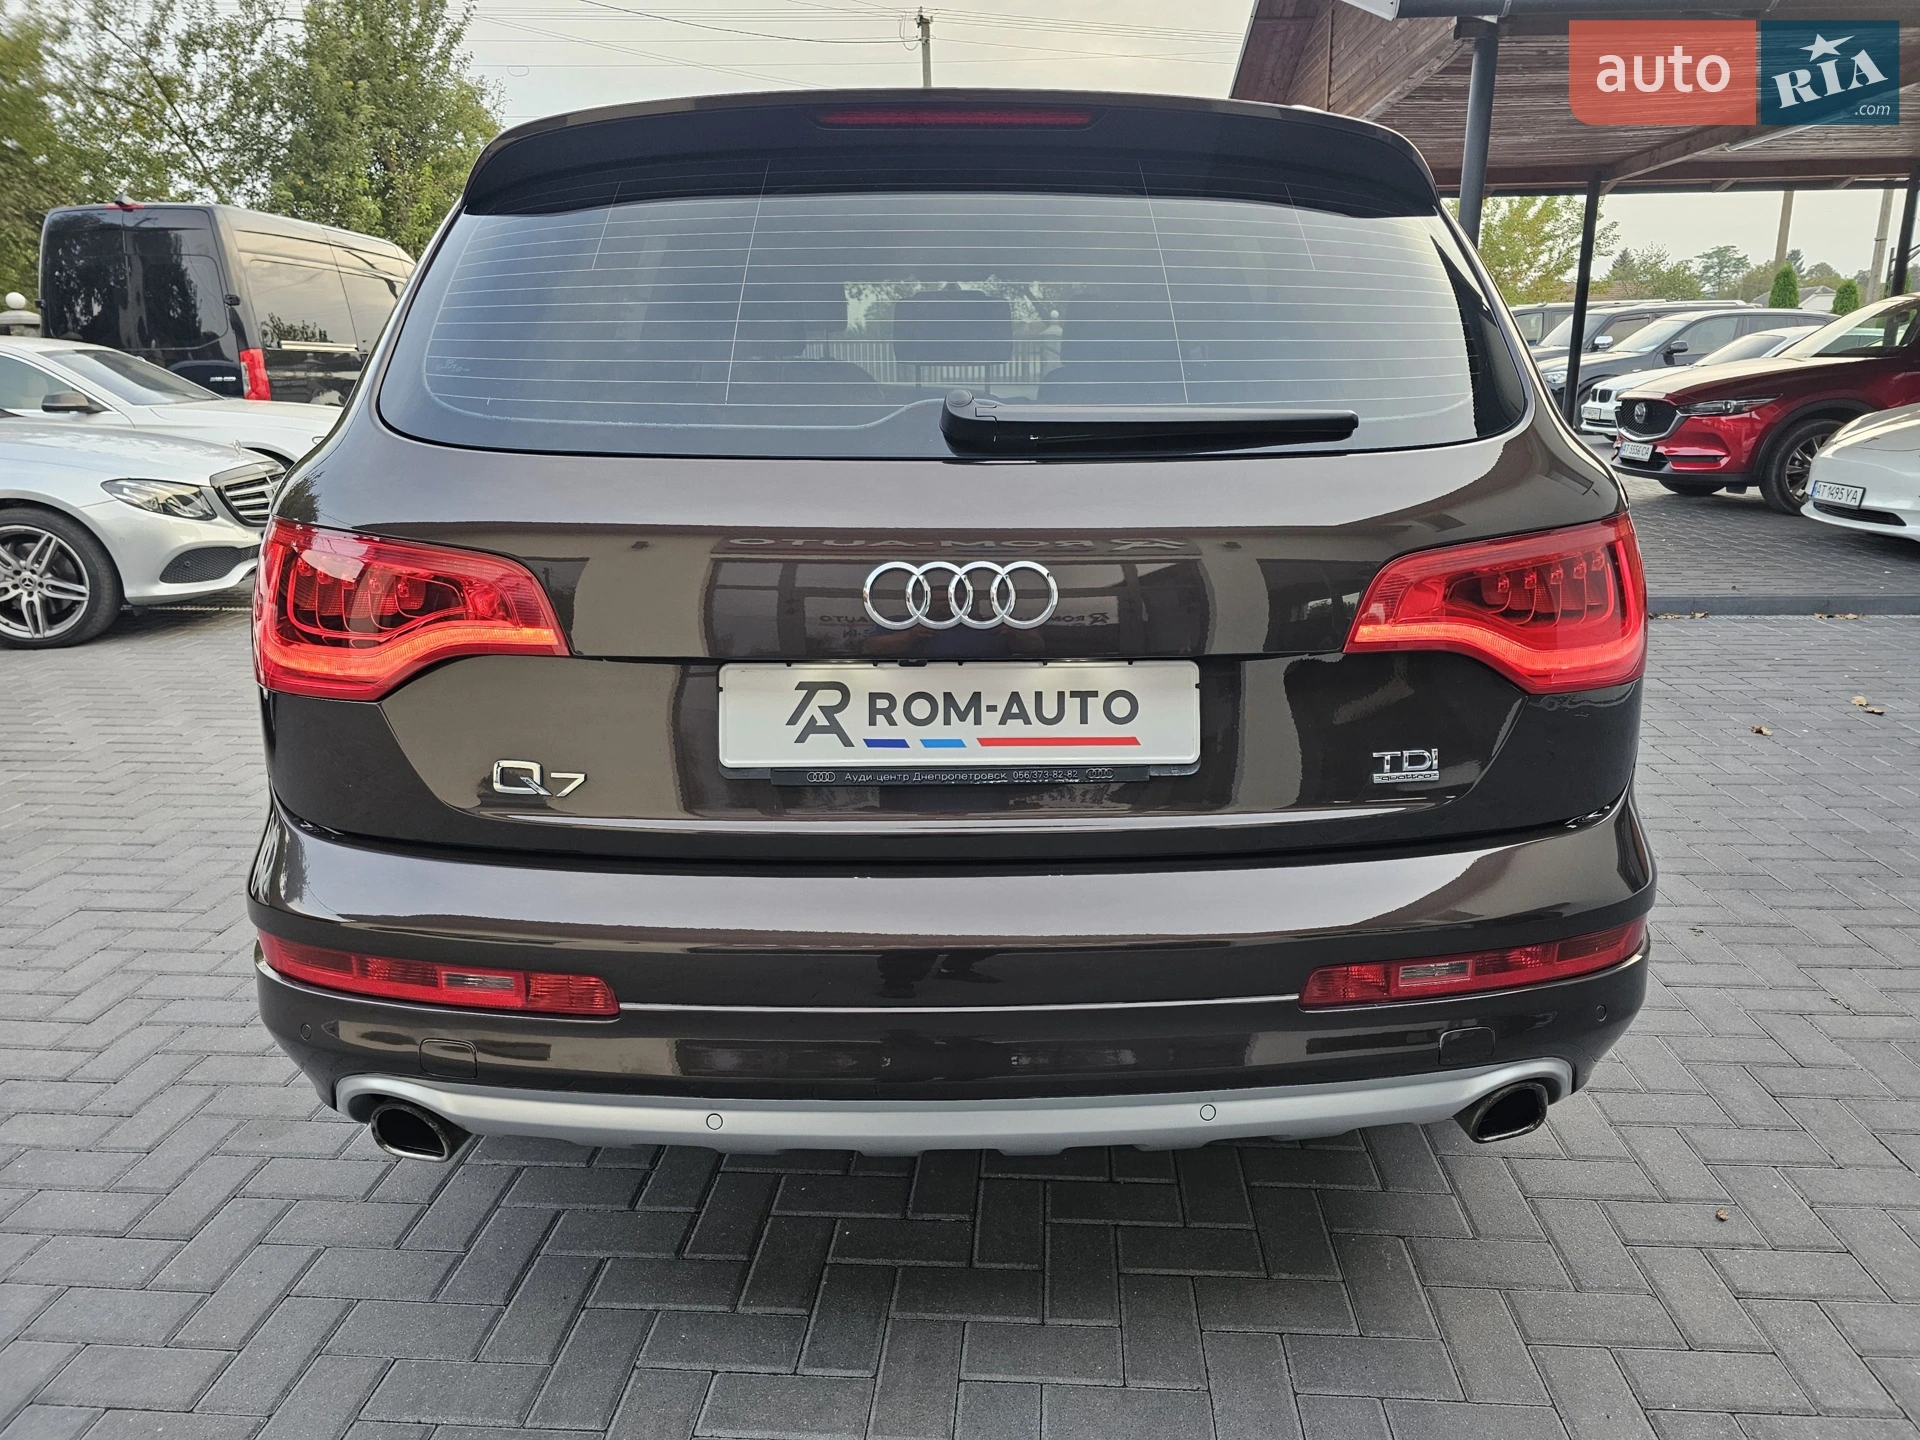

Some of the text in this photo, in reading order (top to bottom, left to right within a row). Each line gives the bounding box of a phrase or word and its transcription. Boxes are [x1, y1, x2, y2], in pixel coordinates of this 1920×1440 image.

[1816, 484, 1858, 504] AT 1495 YA
[868, 689, 1139, 727] ROM-AUTO
[1372, 748, 1438, 773] TDI
[493, 760, 587, 798] Q7
[912, 771, 1007, 782] Днепропетровск
[1012, 769, 1078, 780] 056/373-82-82
[1381, 773, 1432, 781] quattro
